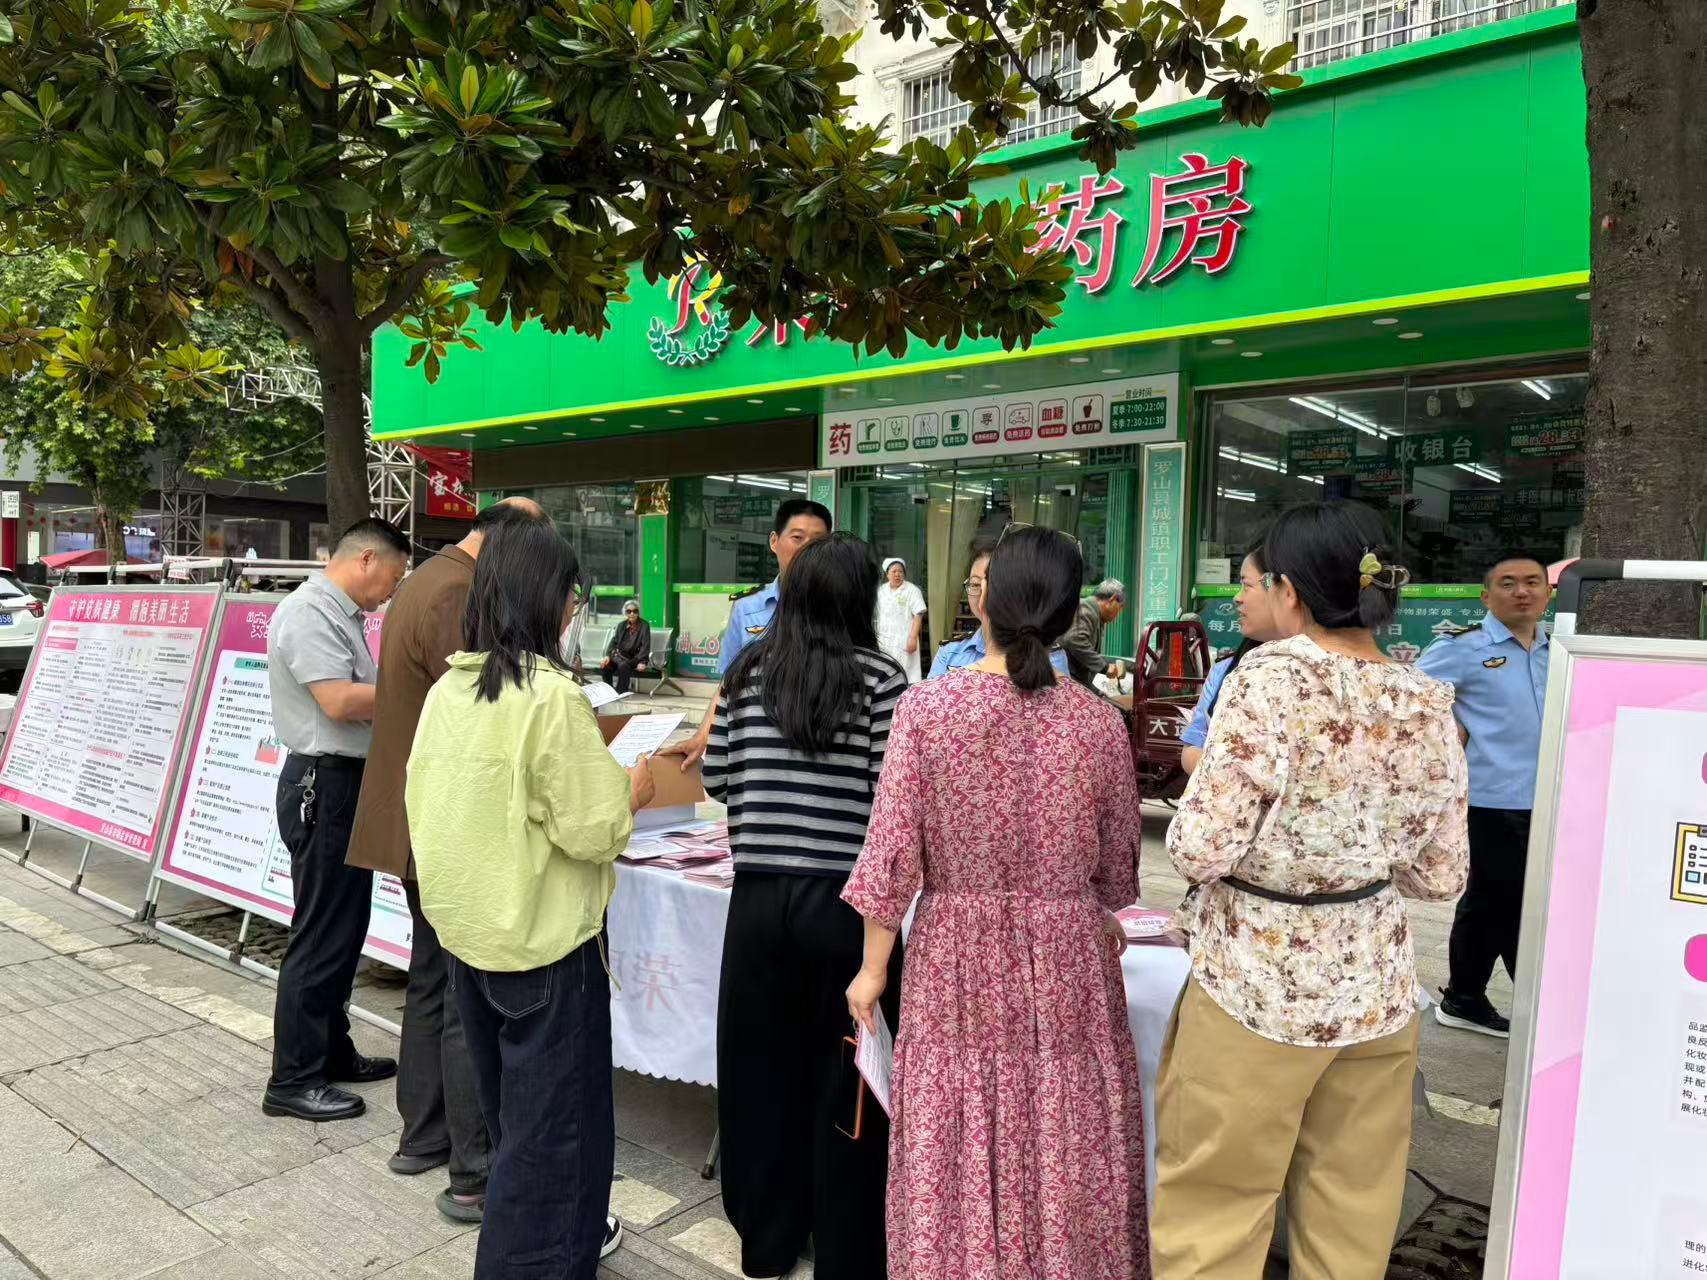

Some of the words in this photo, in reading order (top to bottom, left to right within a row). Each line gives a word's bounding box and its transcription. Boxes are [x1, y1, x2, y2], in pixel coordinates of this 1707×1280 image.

[1023, 152, 1251, 294] 药房
[1126, 388, 1152, 399] 营业时间
[829, 423, 851, 455] 药
[1394, 437, 1472, 461] 收银台
[1208, 620, 1242, 633] 每月
[1684, 1240, 1706, 1254] 理的
[1683, 1257, 1707, 1272] 进化
